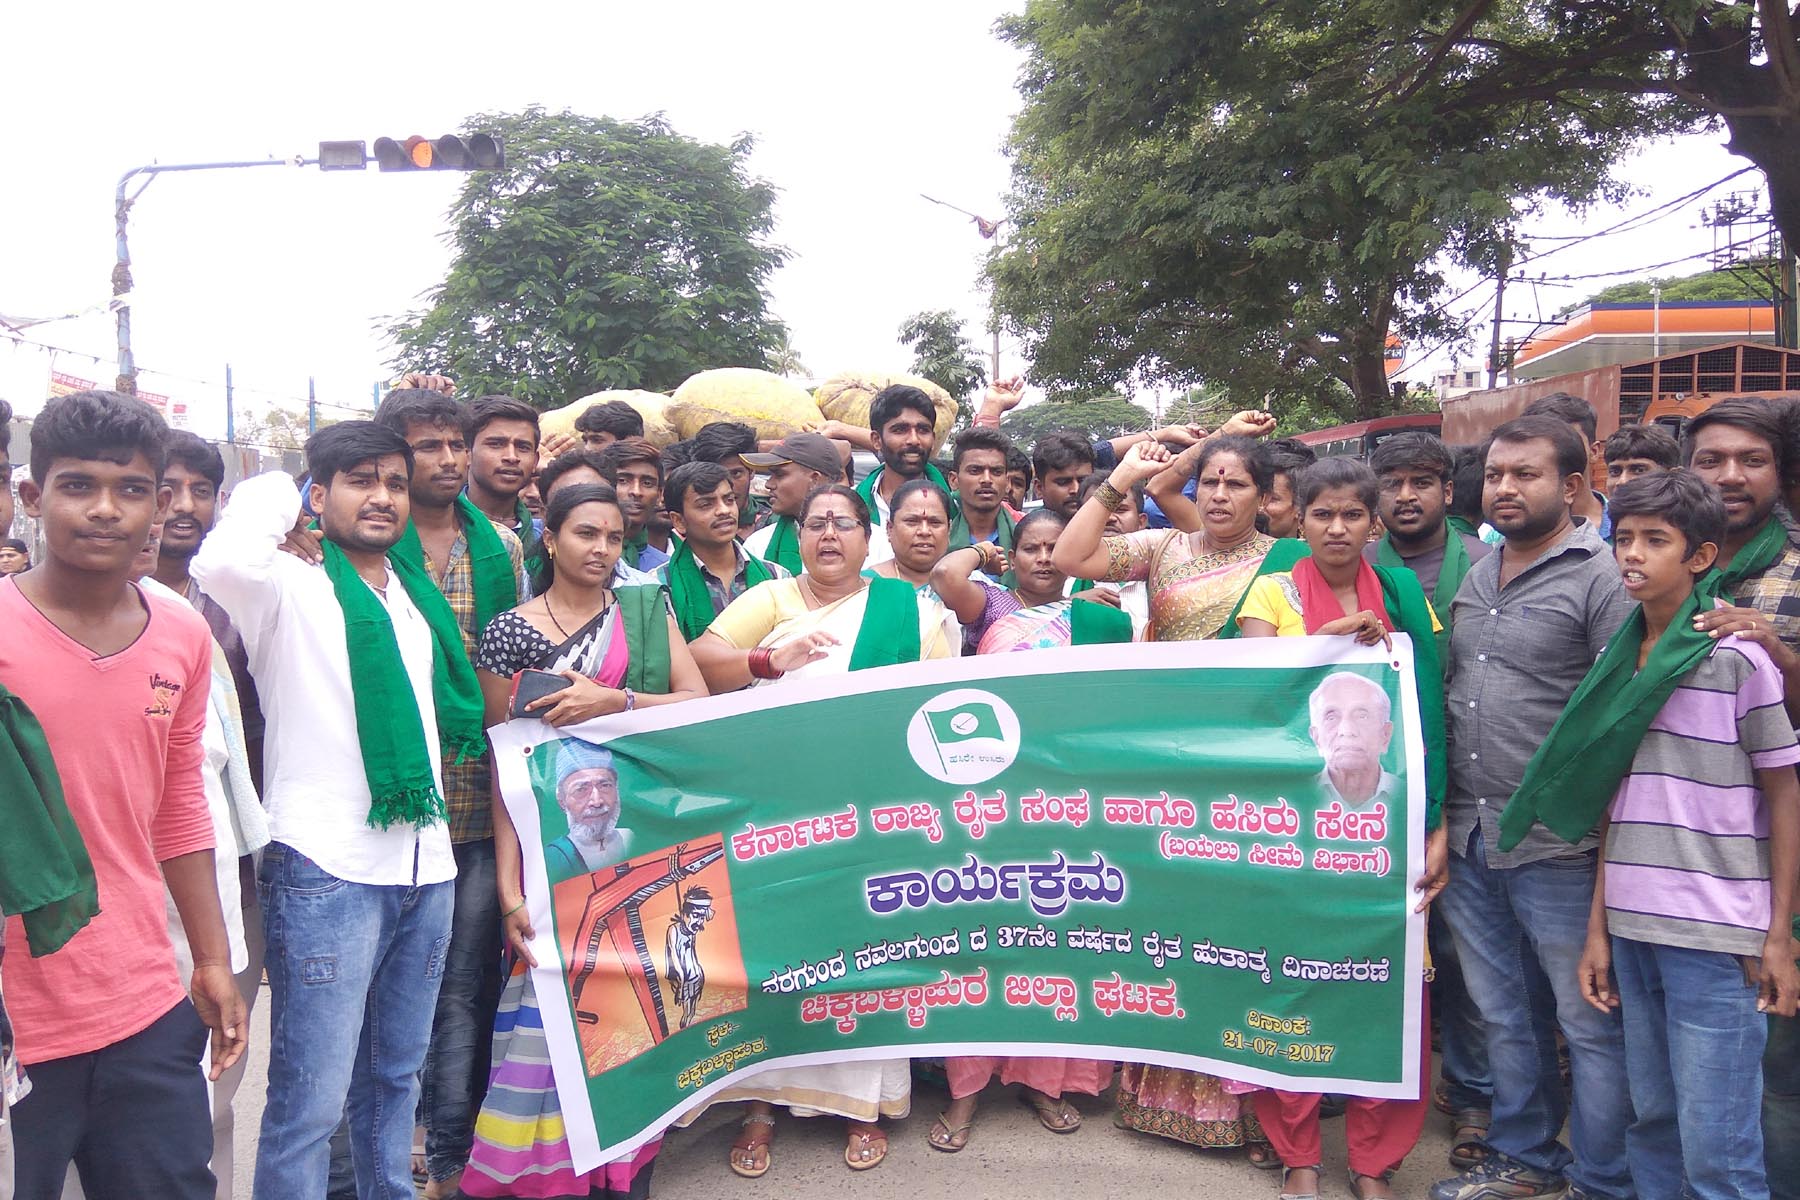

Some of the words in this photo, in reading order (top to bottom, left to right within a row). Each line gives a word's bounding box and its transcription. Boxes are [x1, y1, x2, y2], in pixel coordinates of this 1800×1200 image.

[732, 804, 858, 860] ಕರ್ನಾಟಕ
[872, 803, 943, 842] ರಾಜ್ಯ
[954, 791, 1006, 839] ರೈತ
[1021, 789, 1090, 827] ಸಂಘ
[1104, 791, 1196, 827] ಹಾಗೂ
[1211, 794, 1299, 836] ಹಸಿರು
[1315, 802, 1388, 841] ಸೇನೆ
[1160, 832, 1239, 861] (ಬಯಲು
[1249, 843, 1304, 868] ಸೀಮೆ
[1313, 848, 1391, 877] ವಿಭಾಗ)
[866, 851, 1125, 917] ಕಾರ್ಯಕ್ರಮ
[854, 928, 960, 971] ನವಲಗುಂದ
[969, 925, 988, 951] ದ
[998, 924, 1057, 948] 37ನೇ
[1067, 924, 1132, 954] ವರ್ಷದ
[1143, 932, 1182, 968] ರೈತ
[1192, 937, 1272, 984] ಹುತಾತ್ಮ
[1282, 955, 1391, 983] ದಿನಾಚರಣೆ
[801, 966, 989, 1034] ಚಿಕ್ಕಬಳ್ಳಾಪುರ
[1005, 974, 1079, 1022] ಜಿಲ್ಲಾ
[1093, 971, 1186, 1019] ಘಟಕ.
[1247, 1010, 1311, 1036] ದಿನಾಂಕ:
[1223, 1030, 1335, 1063] 21-07-2017
